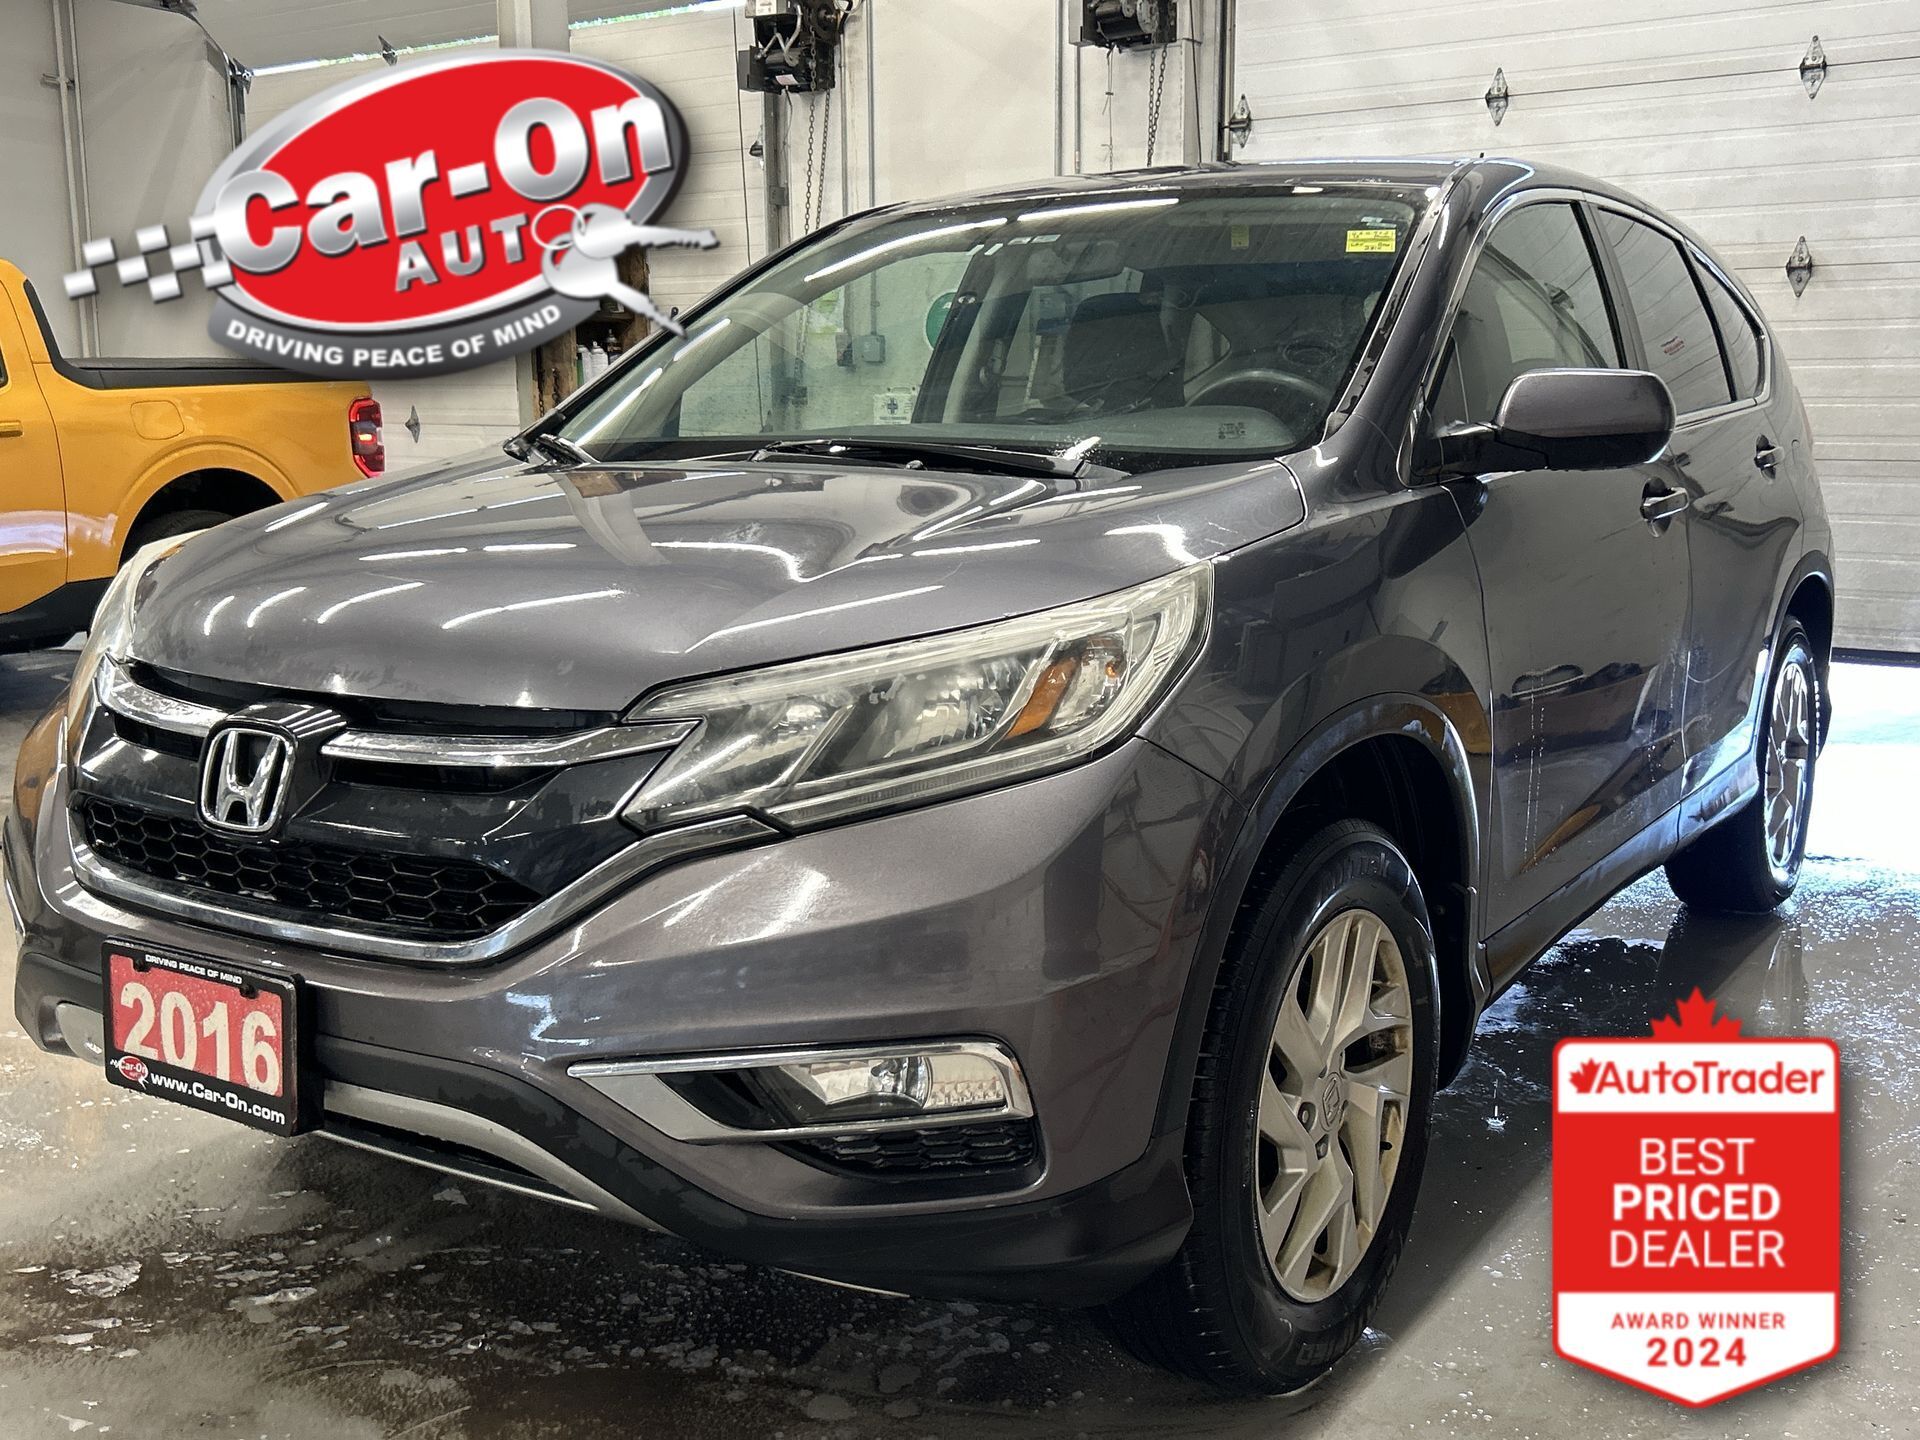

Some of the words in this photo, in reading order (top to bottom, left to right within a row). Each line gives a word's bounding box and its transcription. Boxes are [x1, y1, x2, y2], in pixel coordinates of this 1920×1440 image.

[145, 954, 178, 968] DRIVING
[179, 961, 206, 974] PEACE
[207, 968, 219, 978] OF
[220, 971, 243, 985] MIND
[120, 982, 280, 1096] 2016
[150, 1072, 286, 1125] www.Car-On.com
